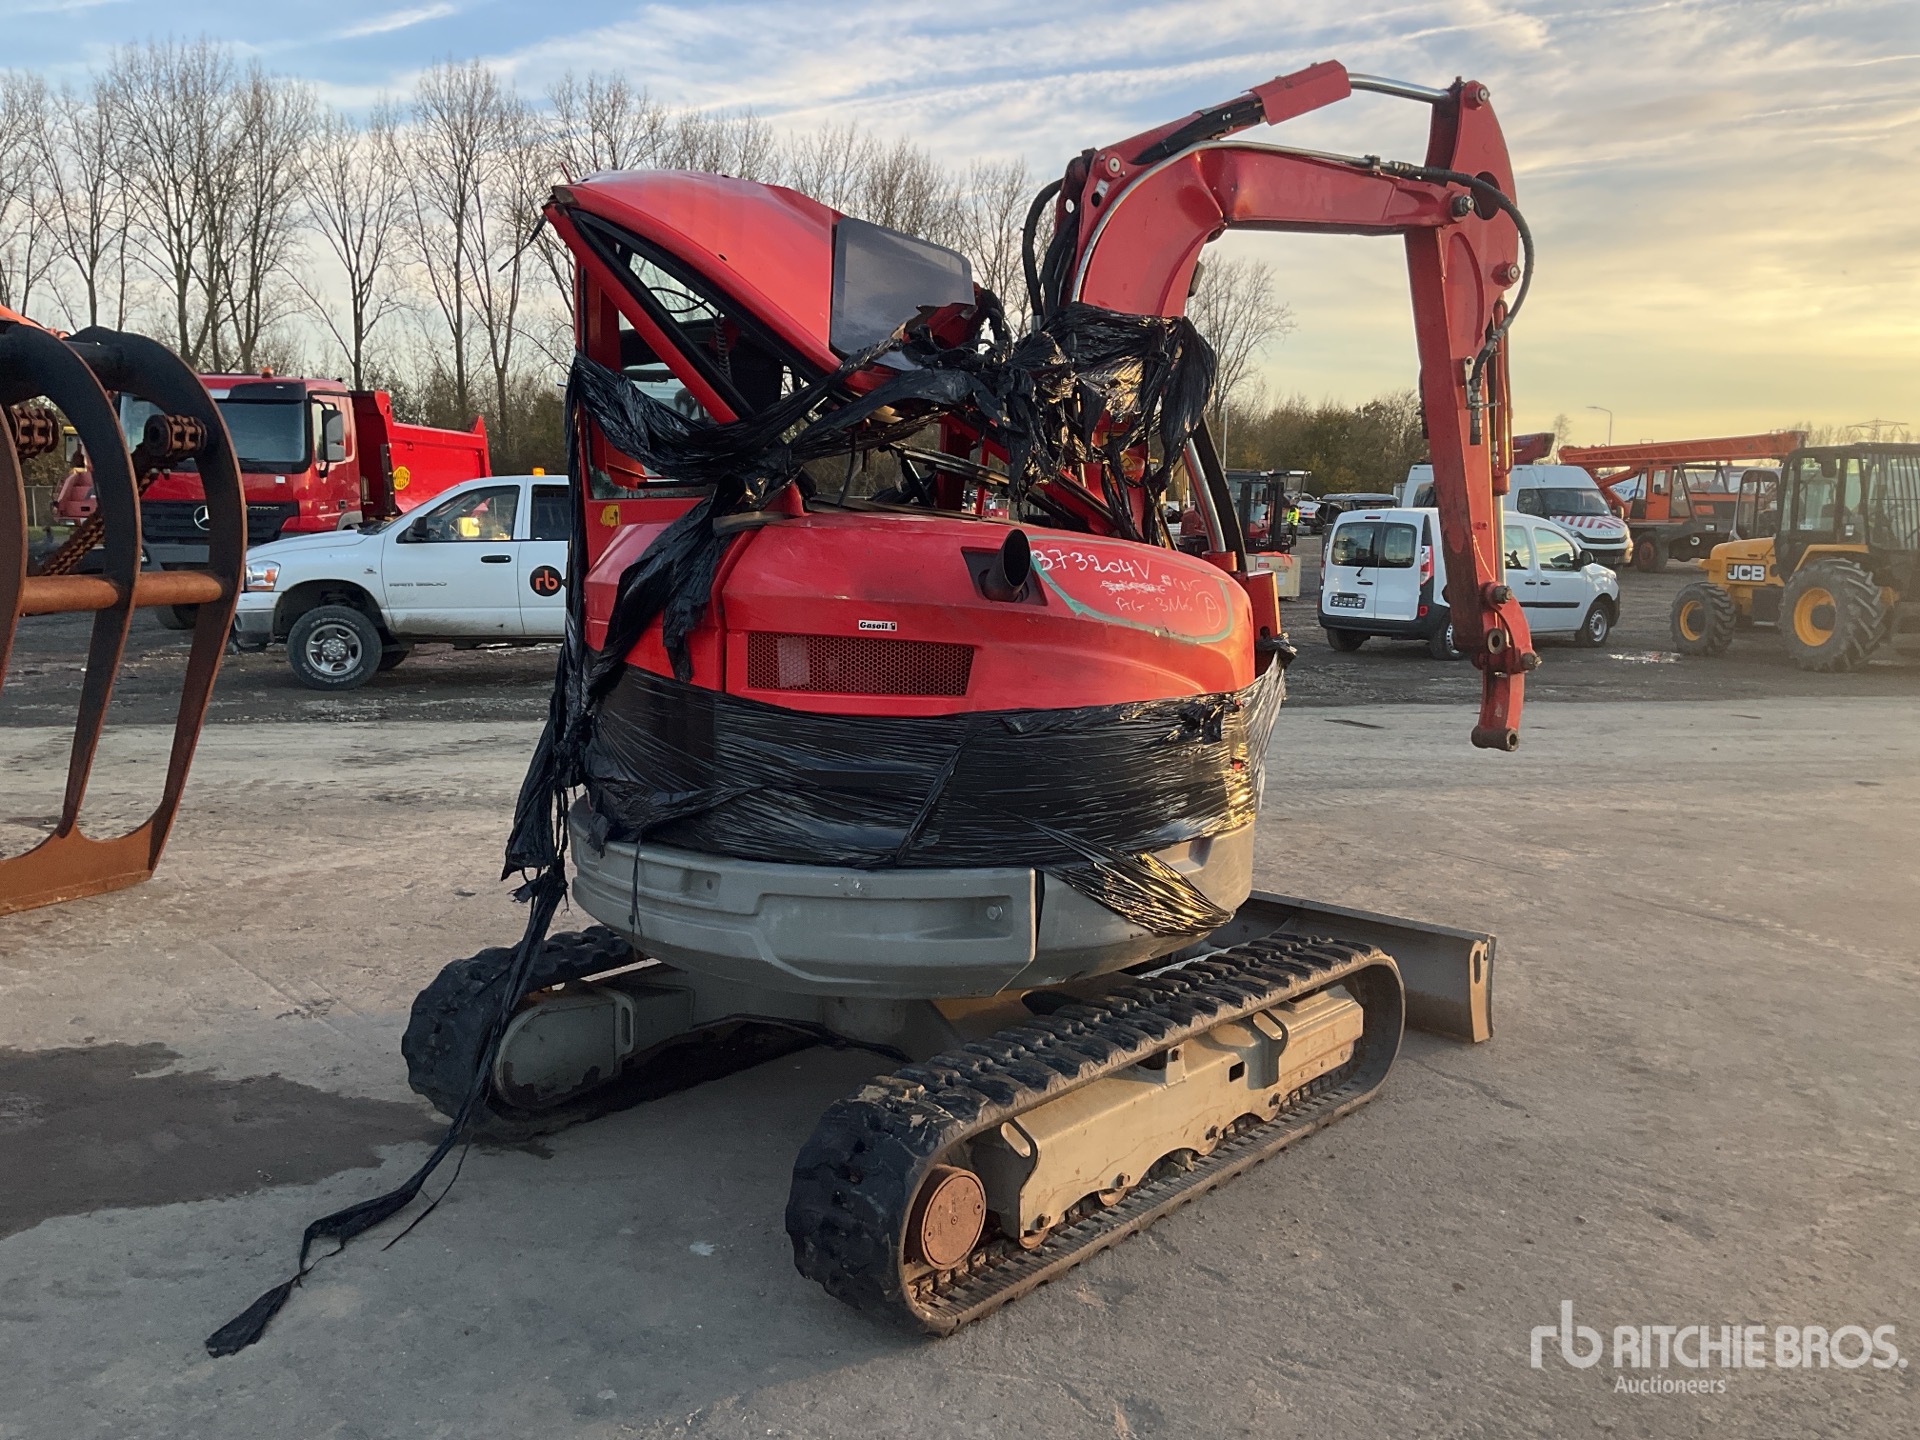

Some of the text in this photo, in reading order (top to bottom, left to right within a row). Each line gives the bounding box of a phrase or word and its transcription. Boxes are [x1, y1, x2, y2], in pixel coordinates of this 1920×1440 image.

[535, 570, 558, 590] rb
[1727, 564, 1765, 581] JCB
[860, 621, 888, 629] Gasoil
